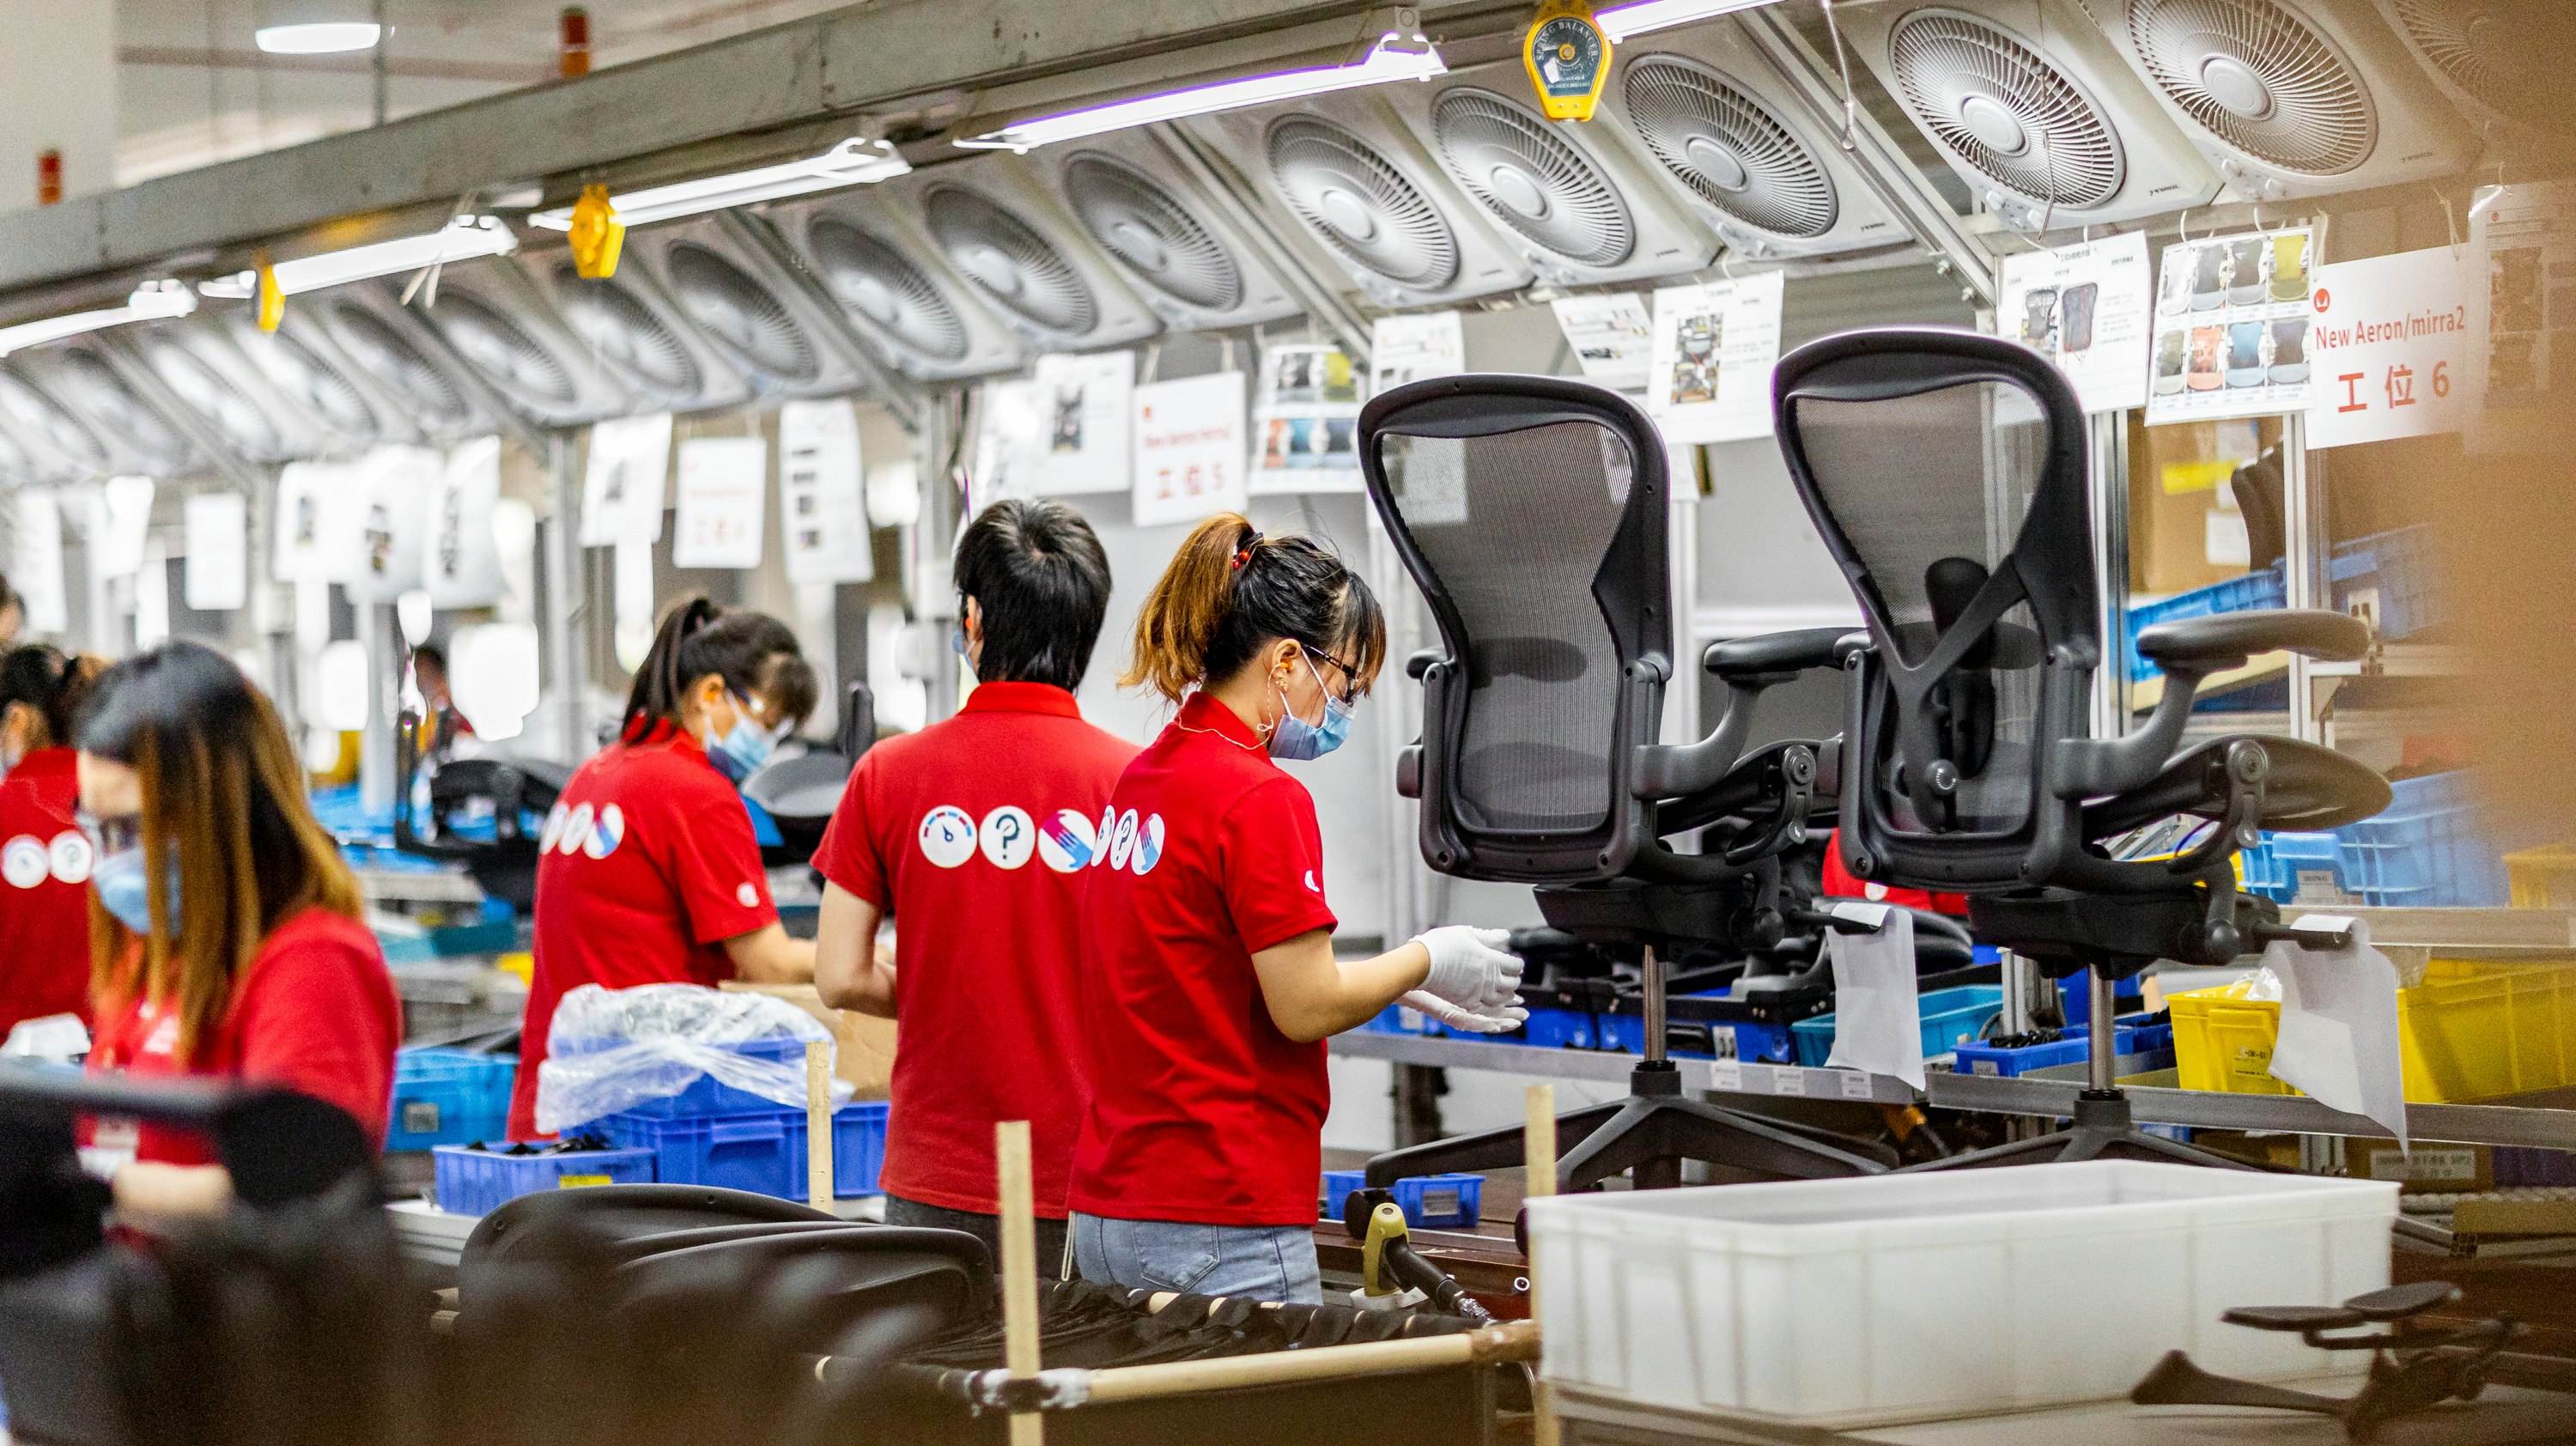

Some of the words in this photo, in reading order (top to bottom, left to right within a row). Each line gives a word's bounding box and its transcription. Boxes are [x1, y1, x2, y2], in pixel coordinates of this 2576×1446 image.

[1558, 21, 1599, 61] BALANCER
[2316, 326, 2349, 350] New
[2355, 306, 2464, 345] Aeron/mirra2
[2433, 361, 2449, 398] 6
